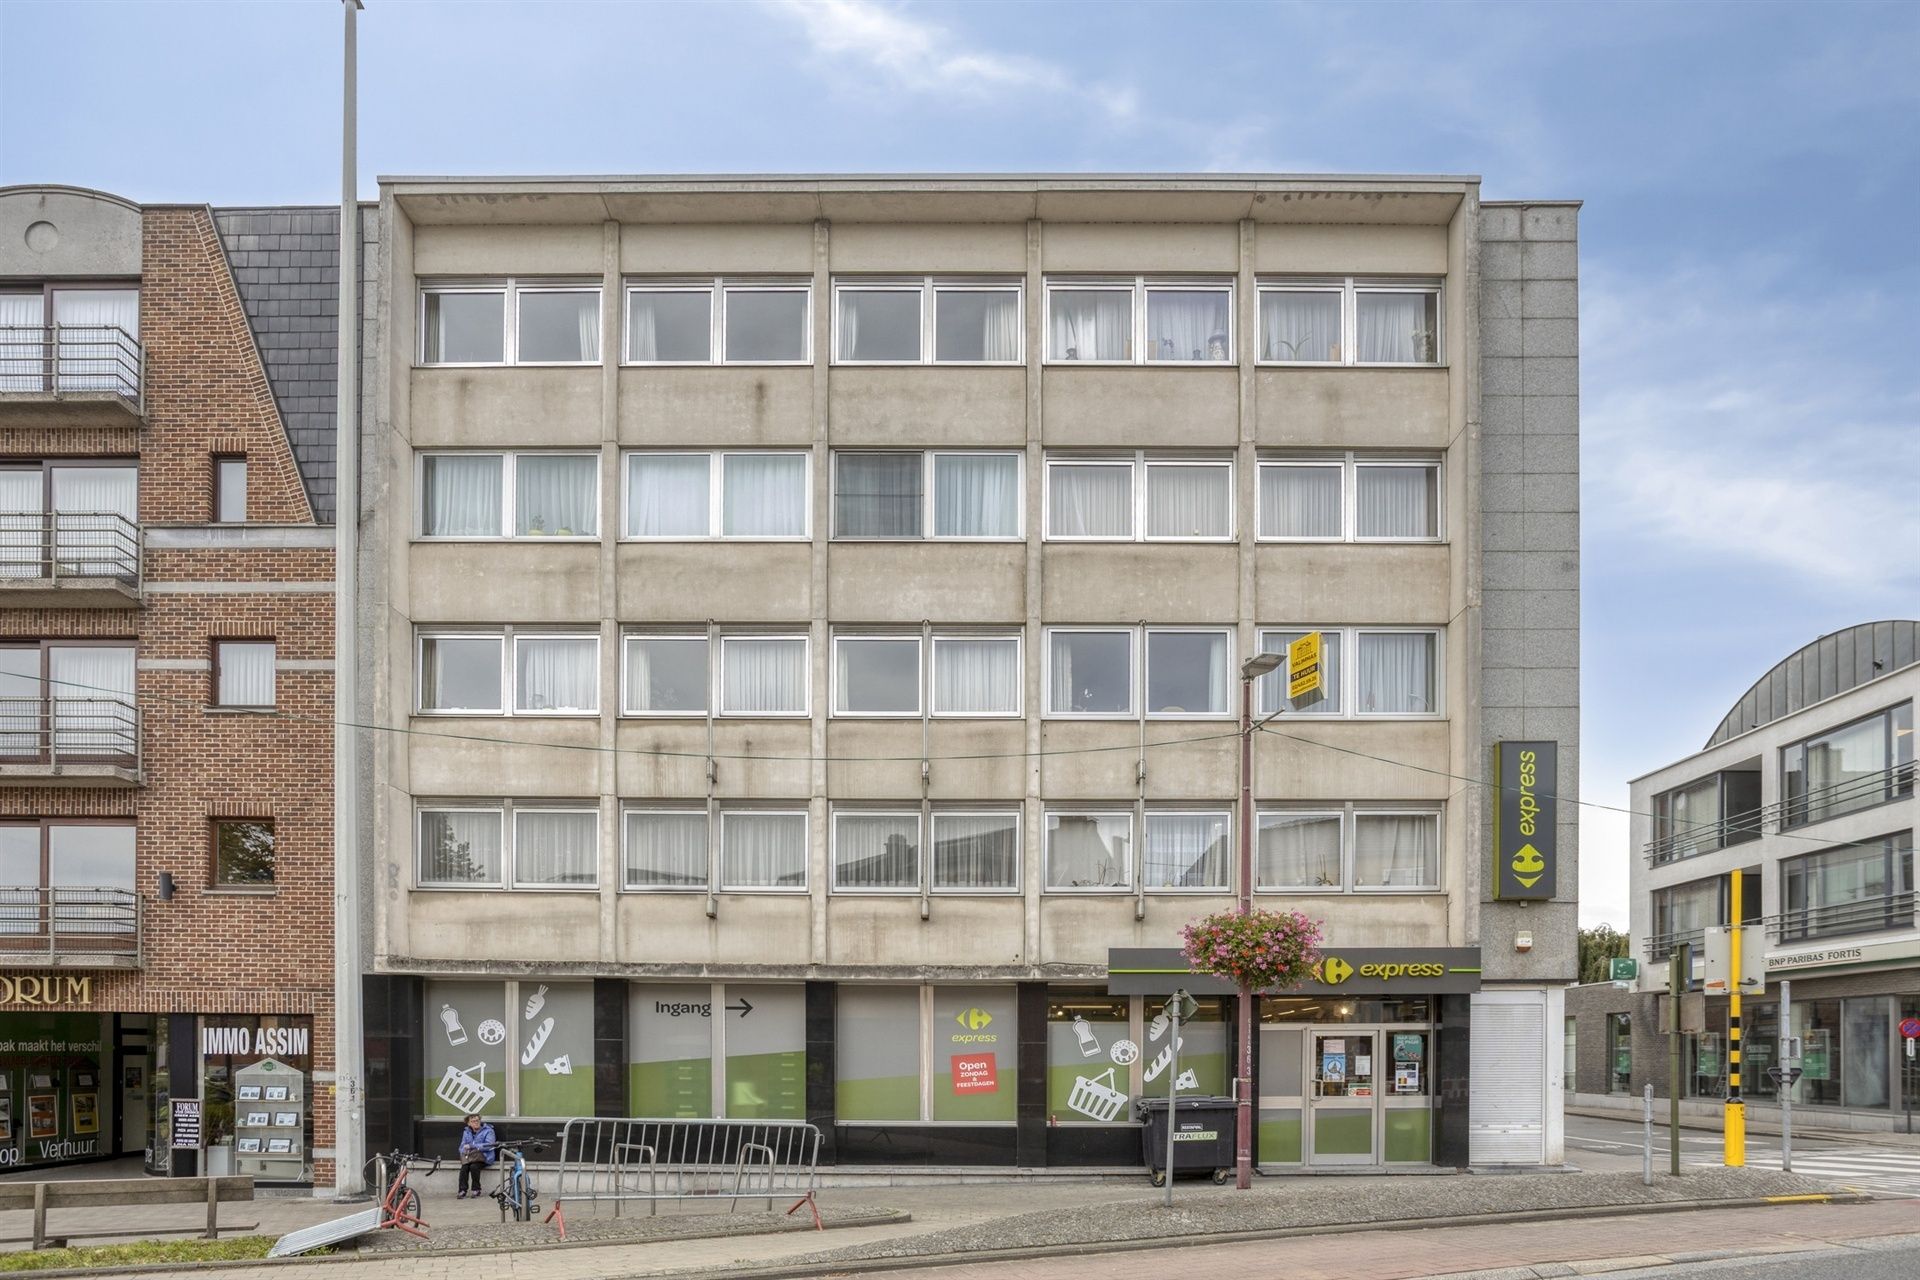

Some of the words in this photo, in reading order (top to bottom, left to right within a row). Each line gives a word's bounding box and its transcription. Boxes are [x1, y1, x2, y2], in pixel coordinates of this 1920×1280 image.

[1520, 751, 1541, 836] express
[1768, 958, 1786, 967] BNP
[1787, 953, 1824, 965] PARIBAS
[1827, 949, 1861, 960] FORTIS
[1360, 963, 1444, 981] express
[655, 1001, 712, 1017] Ingang
[18, 1040, 48, 1052] maakt
[50, 1040, 66, 1052] het
[203, 1027, 250, 1055] IMMO
[254, 1027, 308, 1055] ASSIM
[952, 1034, 998, 1044] express
[959, 1062, 987, 1071] Open
[960, 1070, 989, 1078] ZONDAG
[956, 1080, 995, 1088] FEESTDAGEN
[176, 1102, 199, 1112] FORUM
[0, 1147, 19, 1167] op
[39, 1138, 95, 1159] Verhuur
